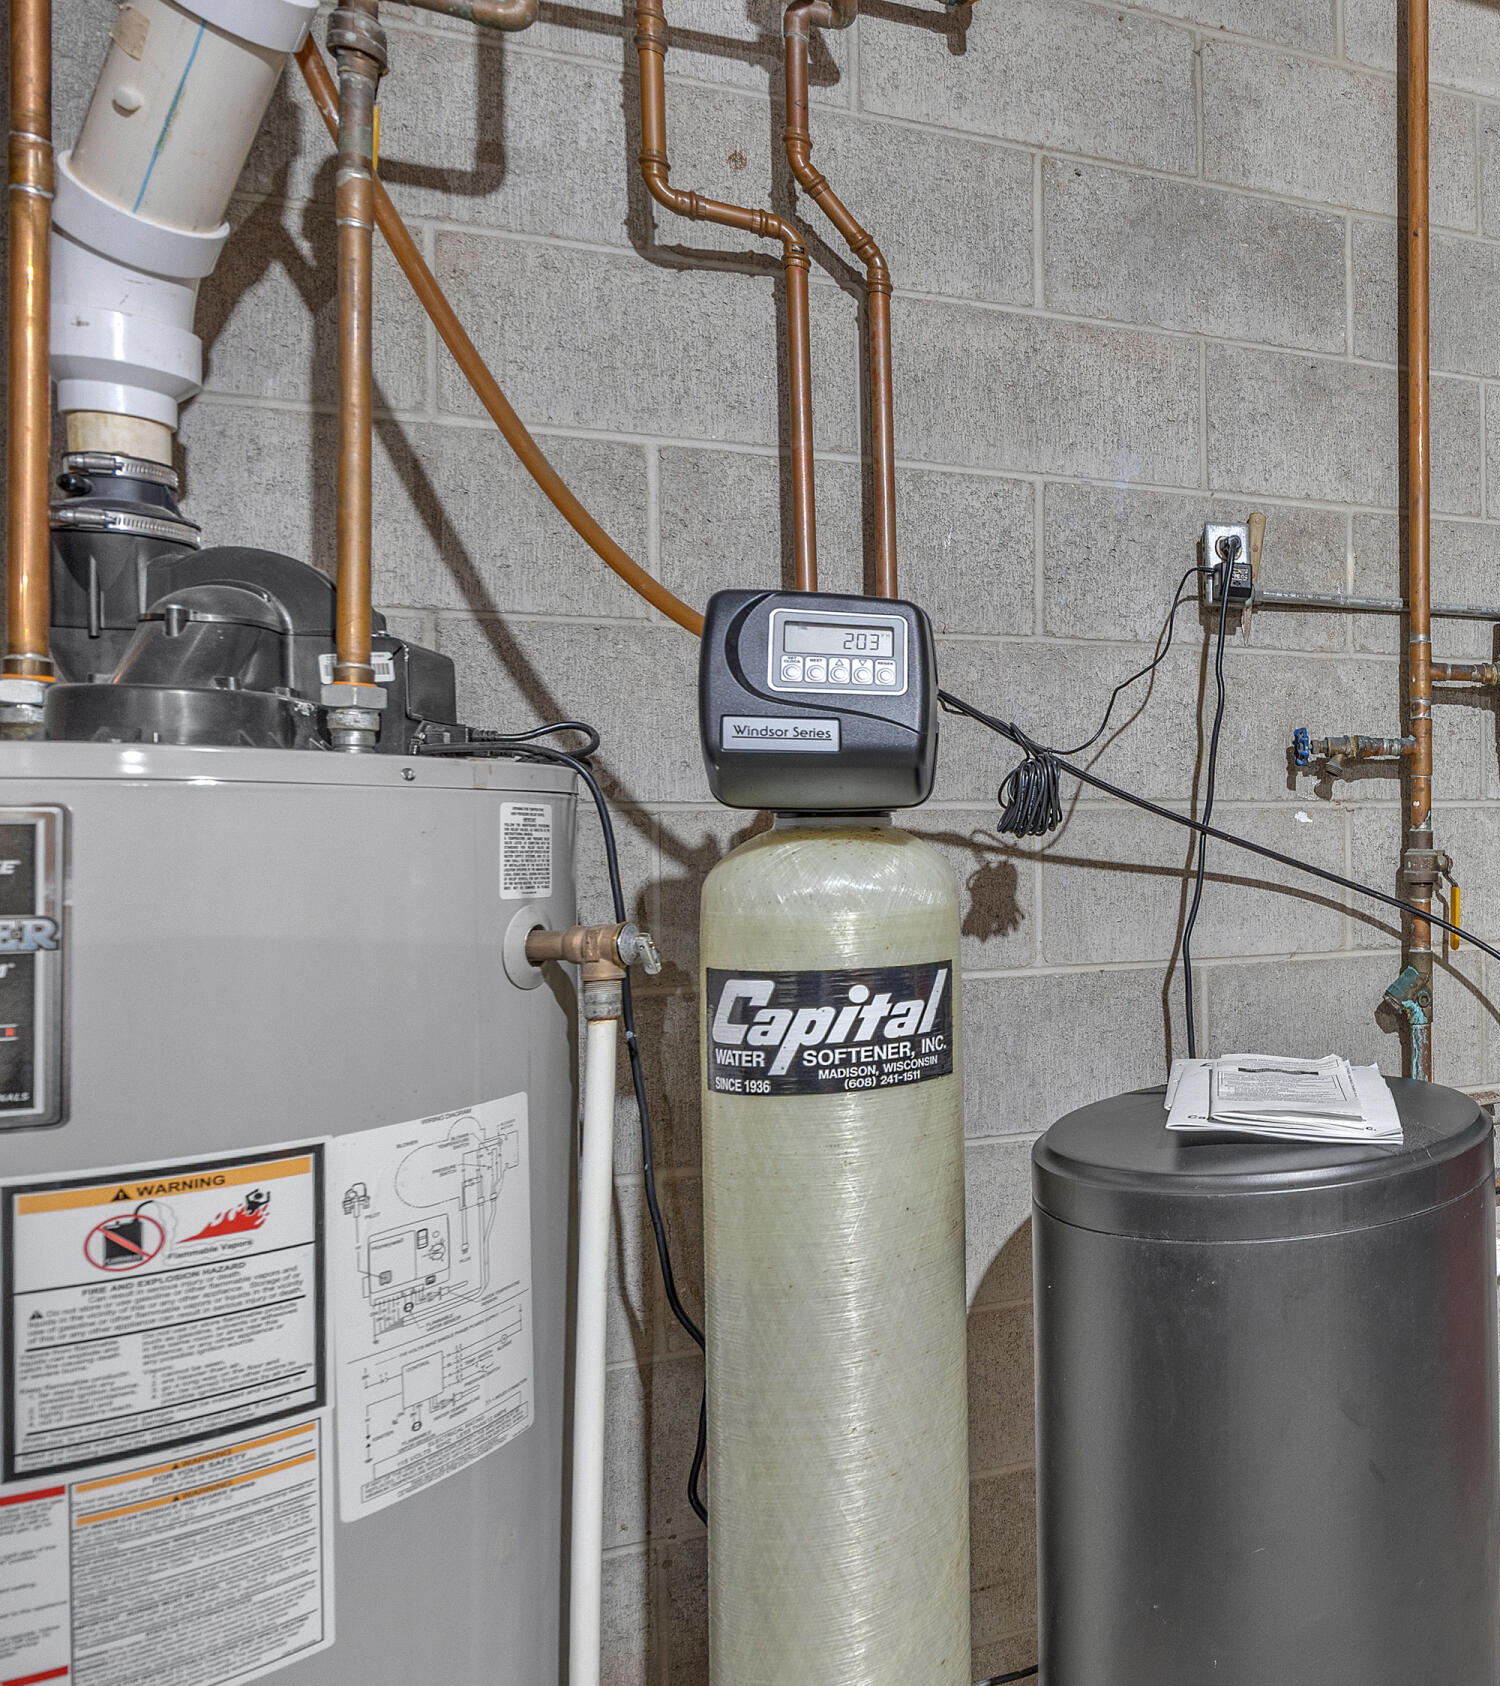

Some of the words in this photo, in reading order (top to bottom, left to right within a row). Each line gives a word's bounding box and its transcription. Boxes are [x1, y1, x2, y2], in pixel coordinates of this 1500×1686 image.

[843, 633, 879, 650] 203
[733, 724, 788, 738] Windsor
[793, 726, 831, 738] Series
[712, 968, 948, 1076] Capital
[715, 1049, 765, 1067] WATER
[802, 1041, 916, 1067] SOFTENER,
[921, 1034, 946, 1052] INC.
[818, 1066, 879, 1080] MADISON,
[883, 1055, 938, 1073] WISCONSIN
[715, 1077, 742, 1092] SINCE
[744, 1080, 771, 1093] 1936
[844, 1076, 876, 1090] (608)
[880, 1070, 921, 1086] 241-1511
[136, 1175, 226, 1197] WARNING
